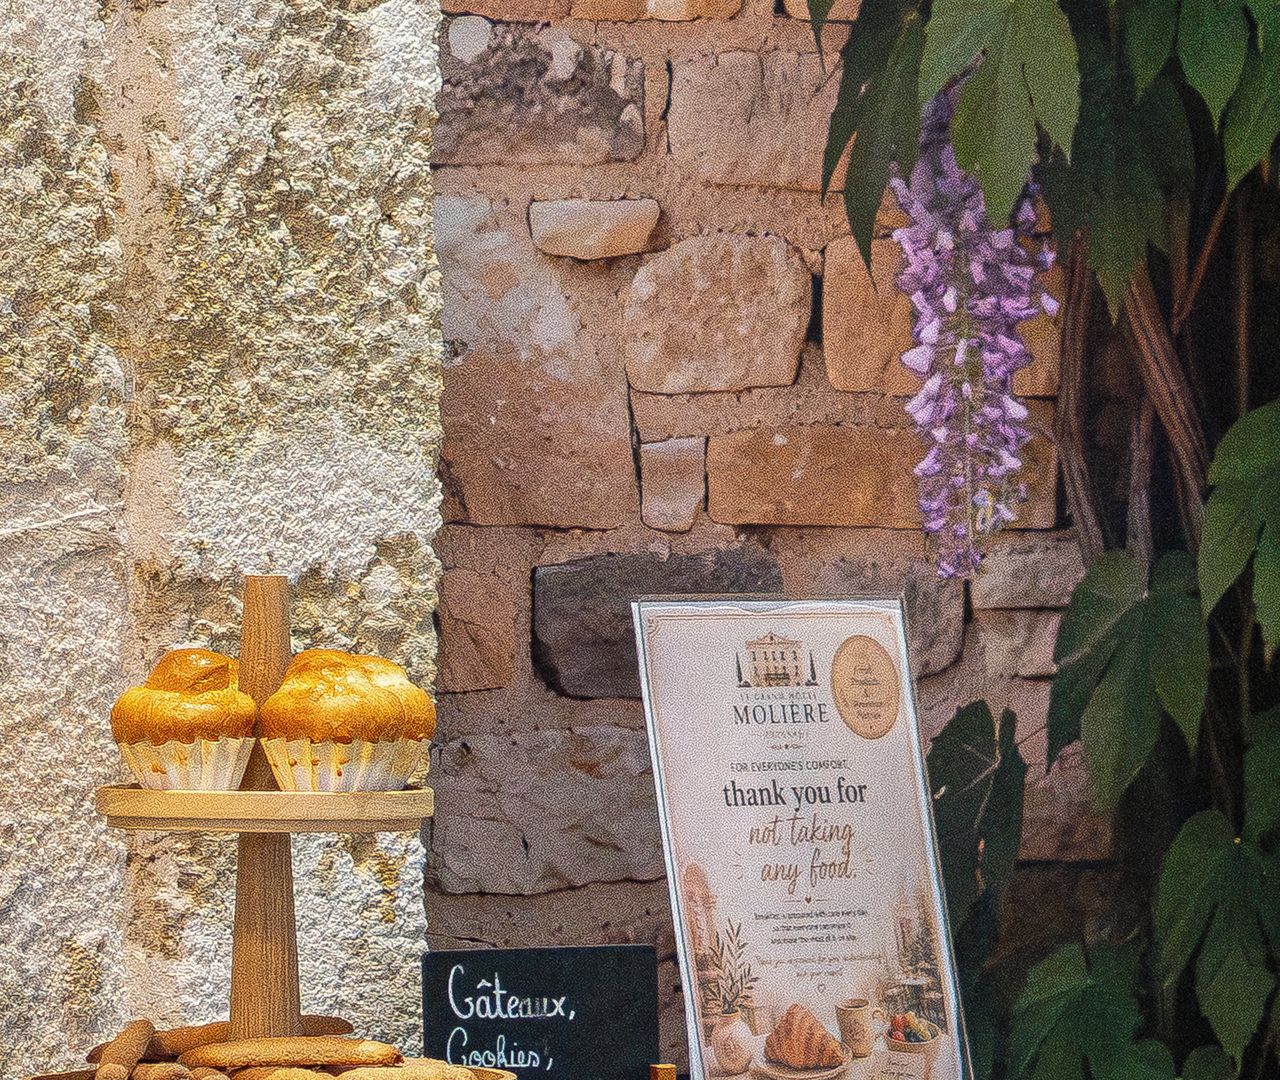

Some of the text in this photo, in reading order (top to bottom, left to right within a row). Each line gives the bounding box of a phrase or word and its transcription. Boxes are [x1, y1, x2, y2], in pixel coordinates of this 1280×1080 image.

[733, 701, 830, 724] MOLIÈRE
[723, 776, 868, 812] thank you for
[749, 813, 857, 857] not taking
[761, 862, 803, 893] any
[448, 964, 575, 1020] Gâteaux,
